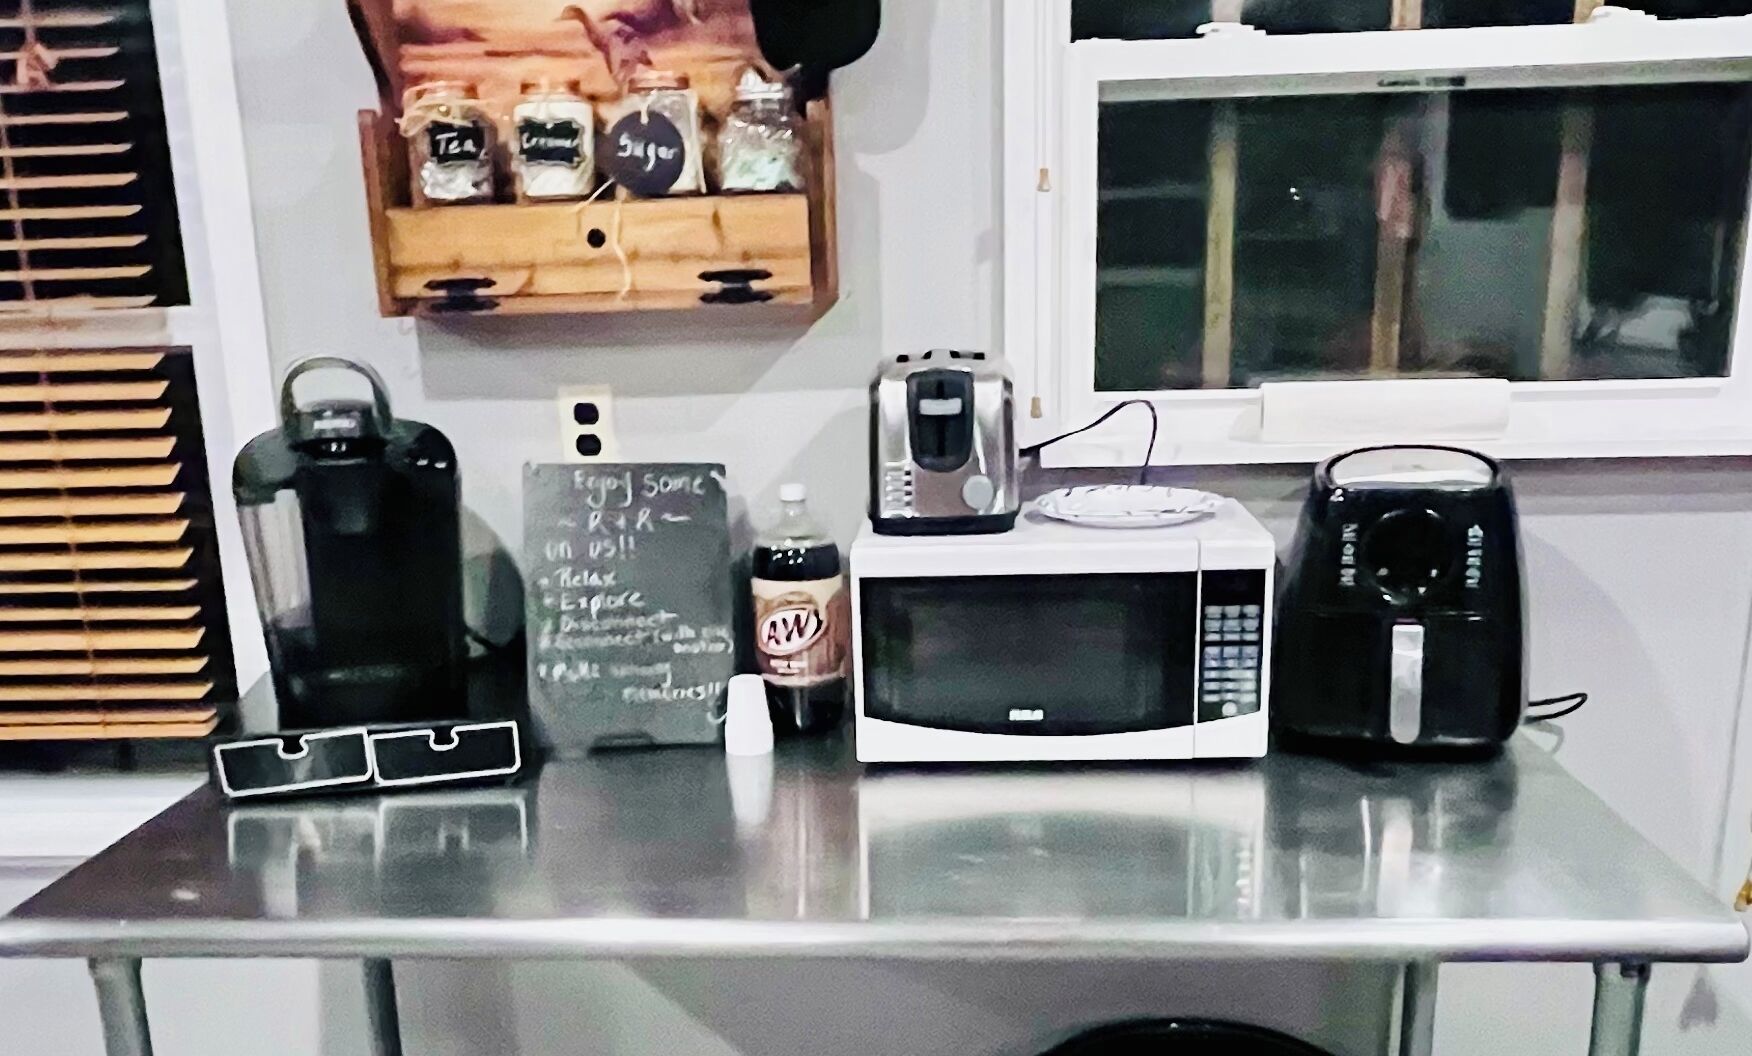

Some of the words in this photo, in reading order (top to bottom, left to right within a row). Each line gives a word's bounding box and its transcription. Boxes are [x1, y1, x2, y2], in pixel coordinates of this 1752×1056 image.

[435, 131, 476, 155] Tea
[616, 131, 678, 173] Sugar
[573, 469, 632, 508] Enjoy
[588, 511, 609, 535] R
[636, 508, 655, 533] R
[553, 568, 618, 588] Relax
[560, 591, 646, 620] Explore
